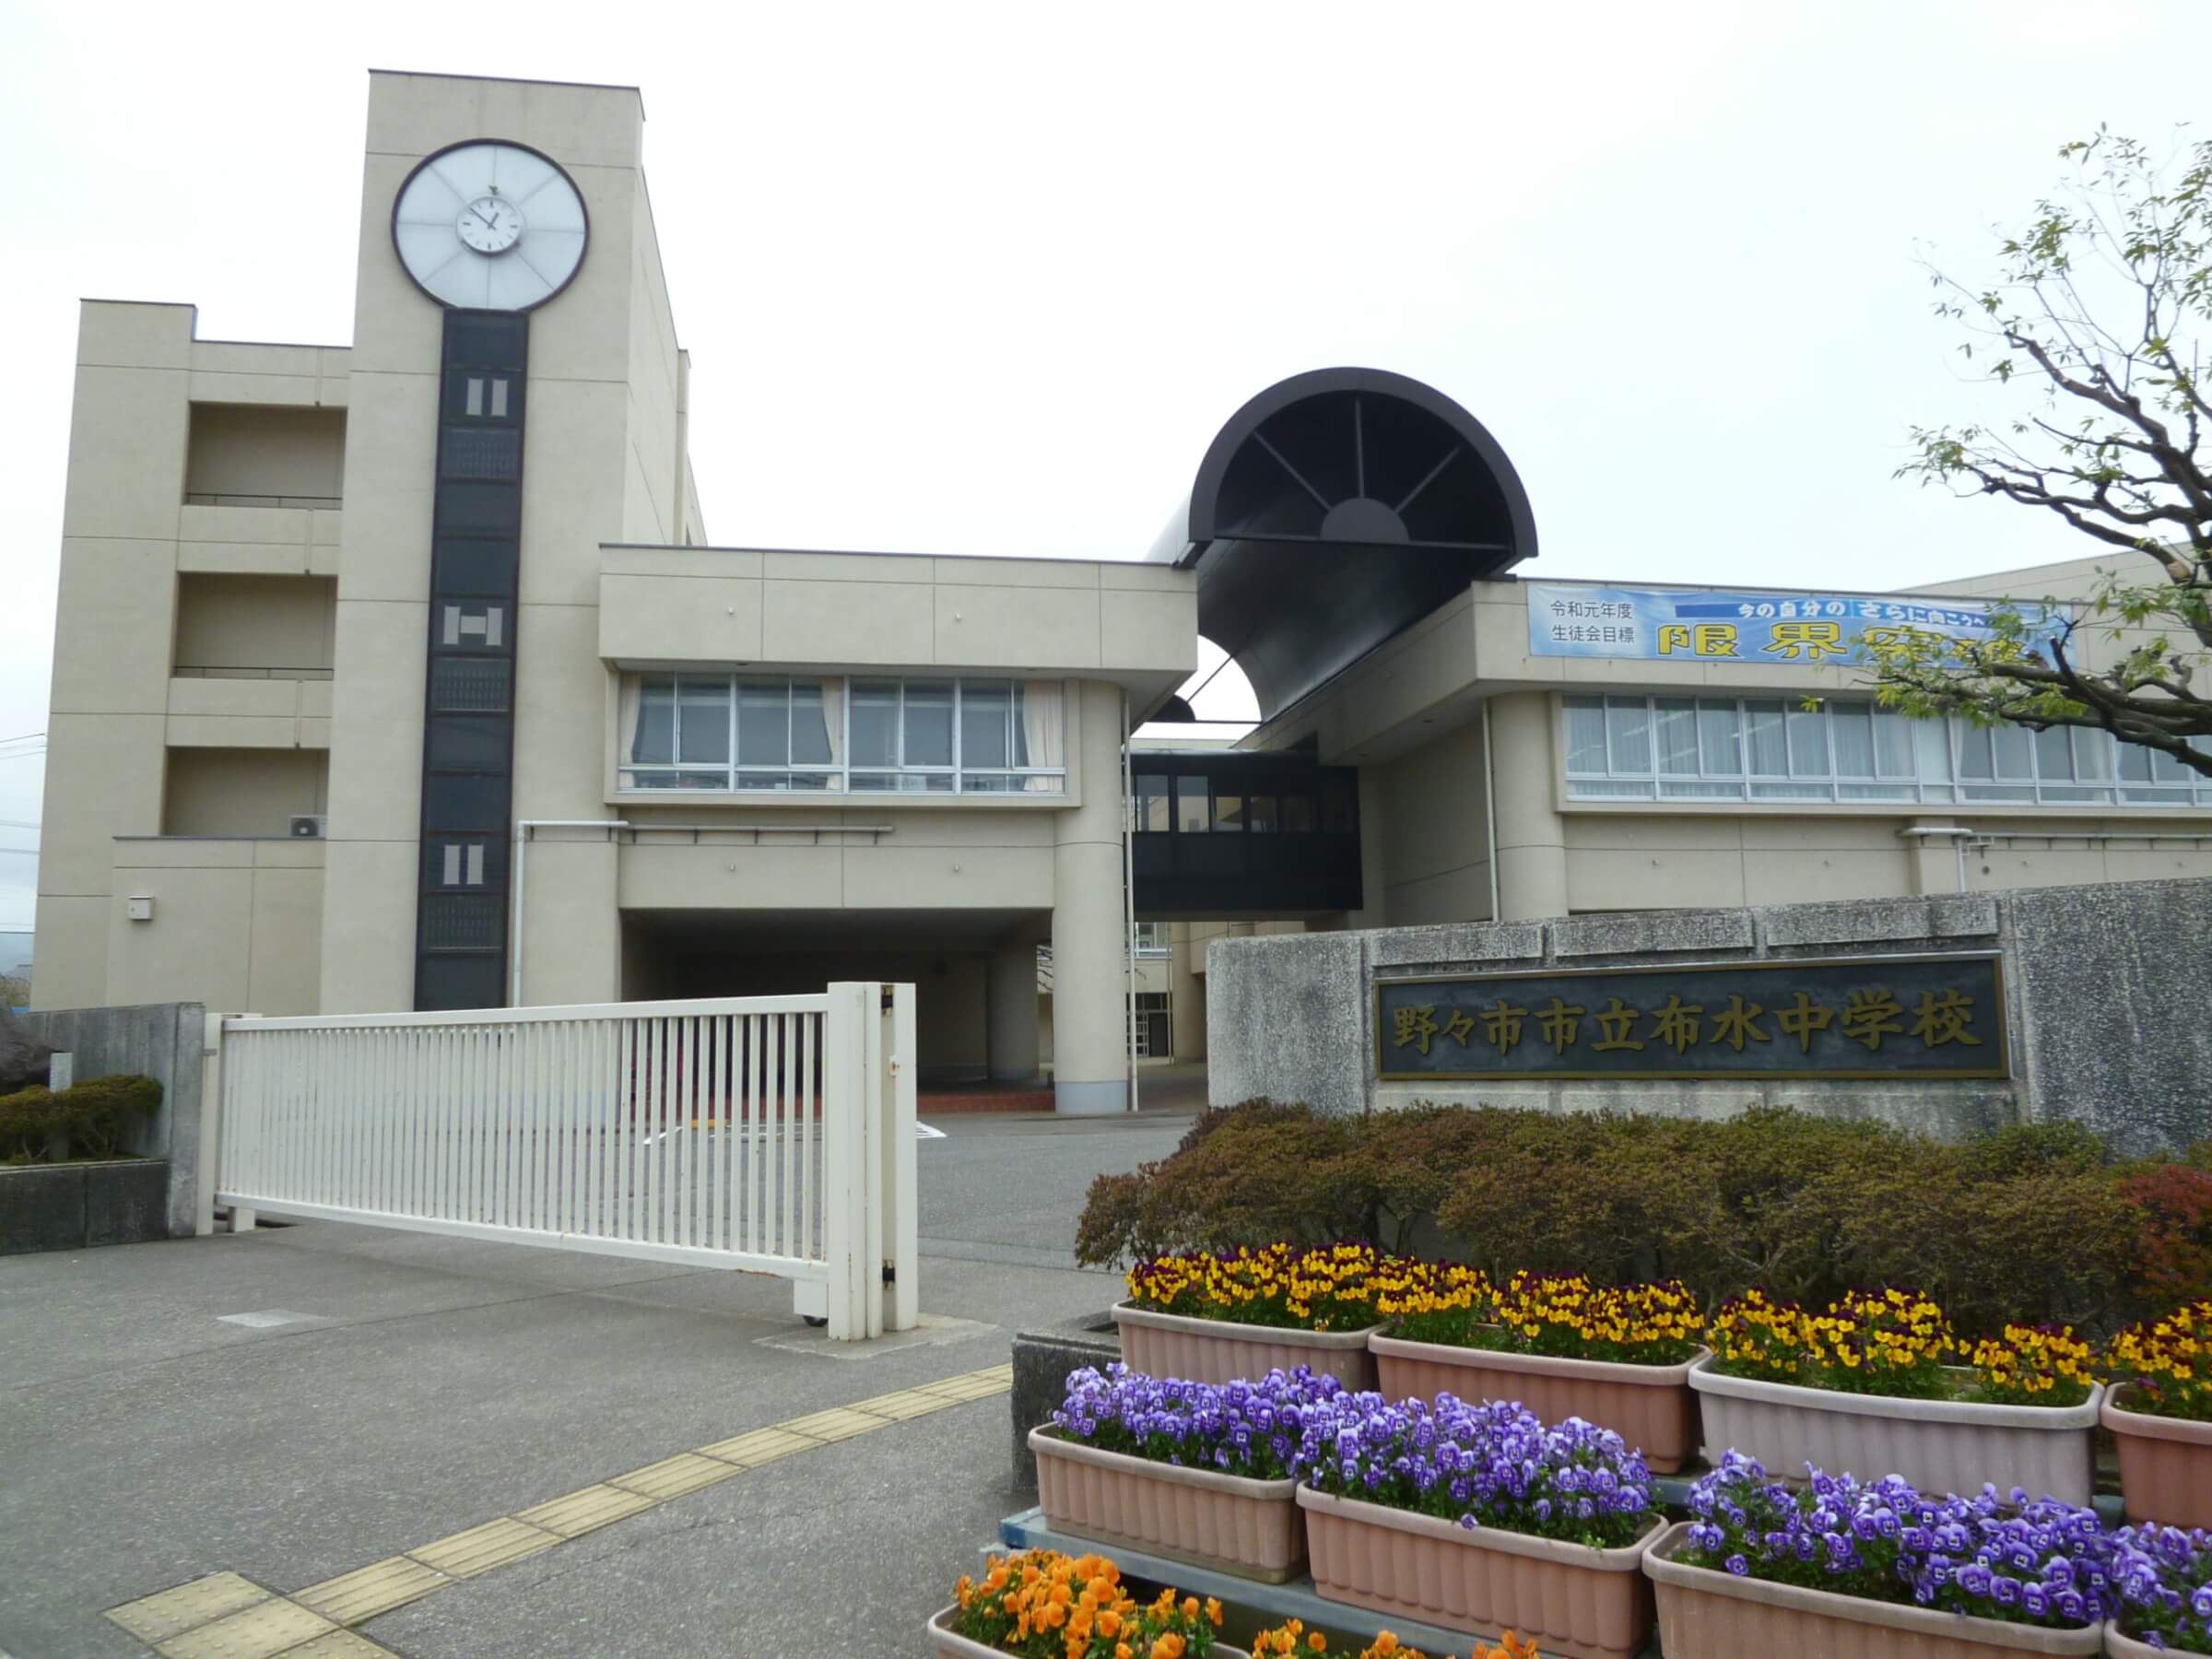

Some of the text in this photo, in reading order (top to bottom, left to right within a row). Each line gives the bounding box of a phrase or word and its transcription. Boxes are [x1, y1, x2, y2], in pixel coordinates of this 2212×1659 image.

[1550, 599, 1633, 619] 令和元年度
[1552, 624, 1635, 643] 生徒会目標
[1393, 988, 1982, 1055] 野々市市立布水中学校
